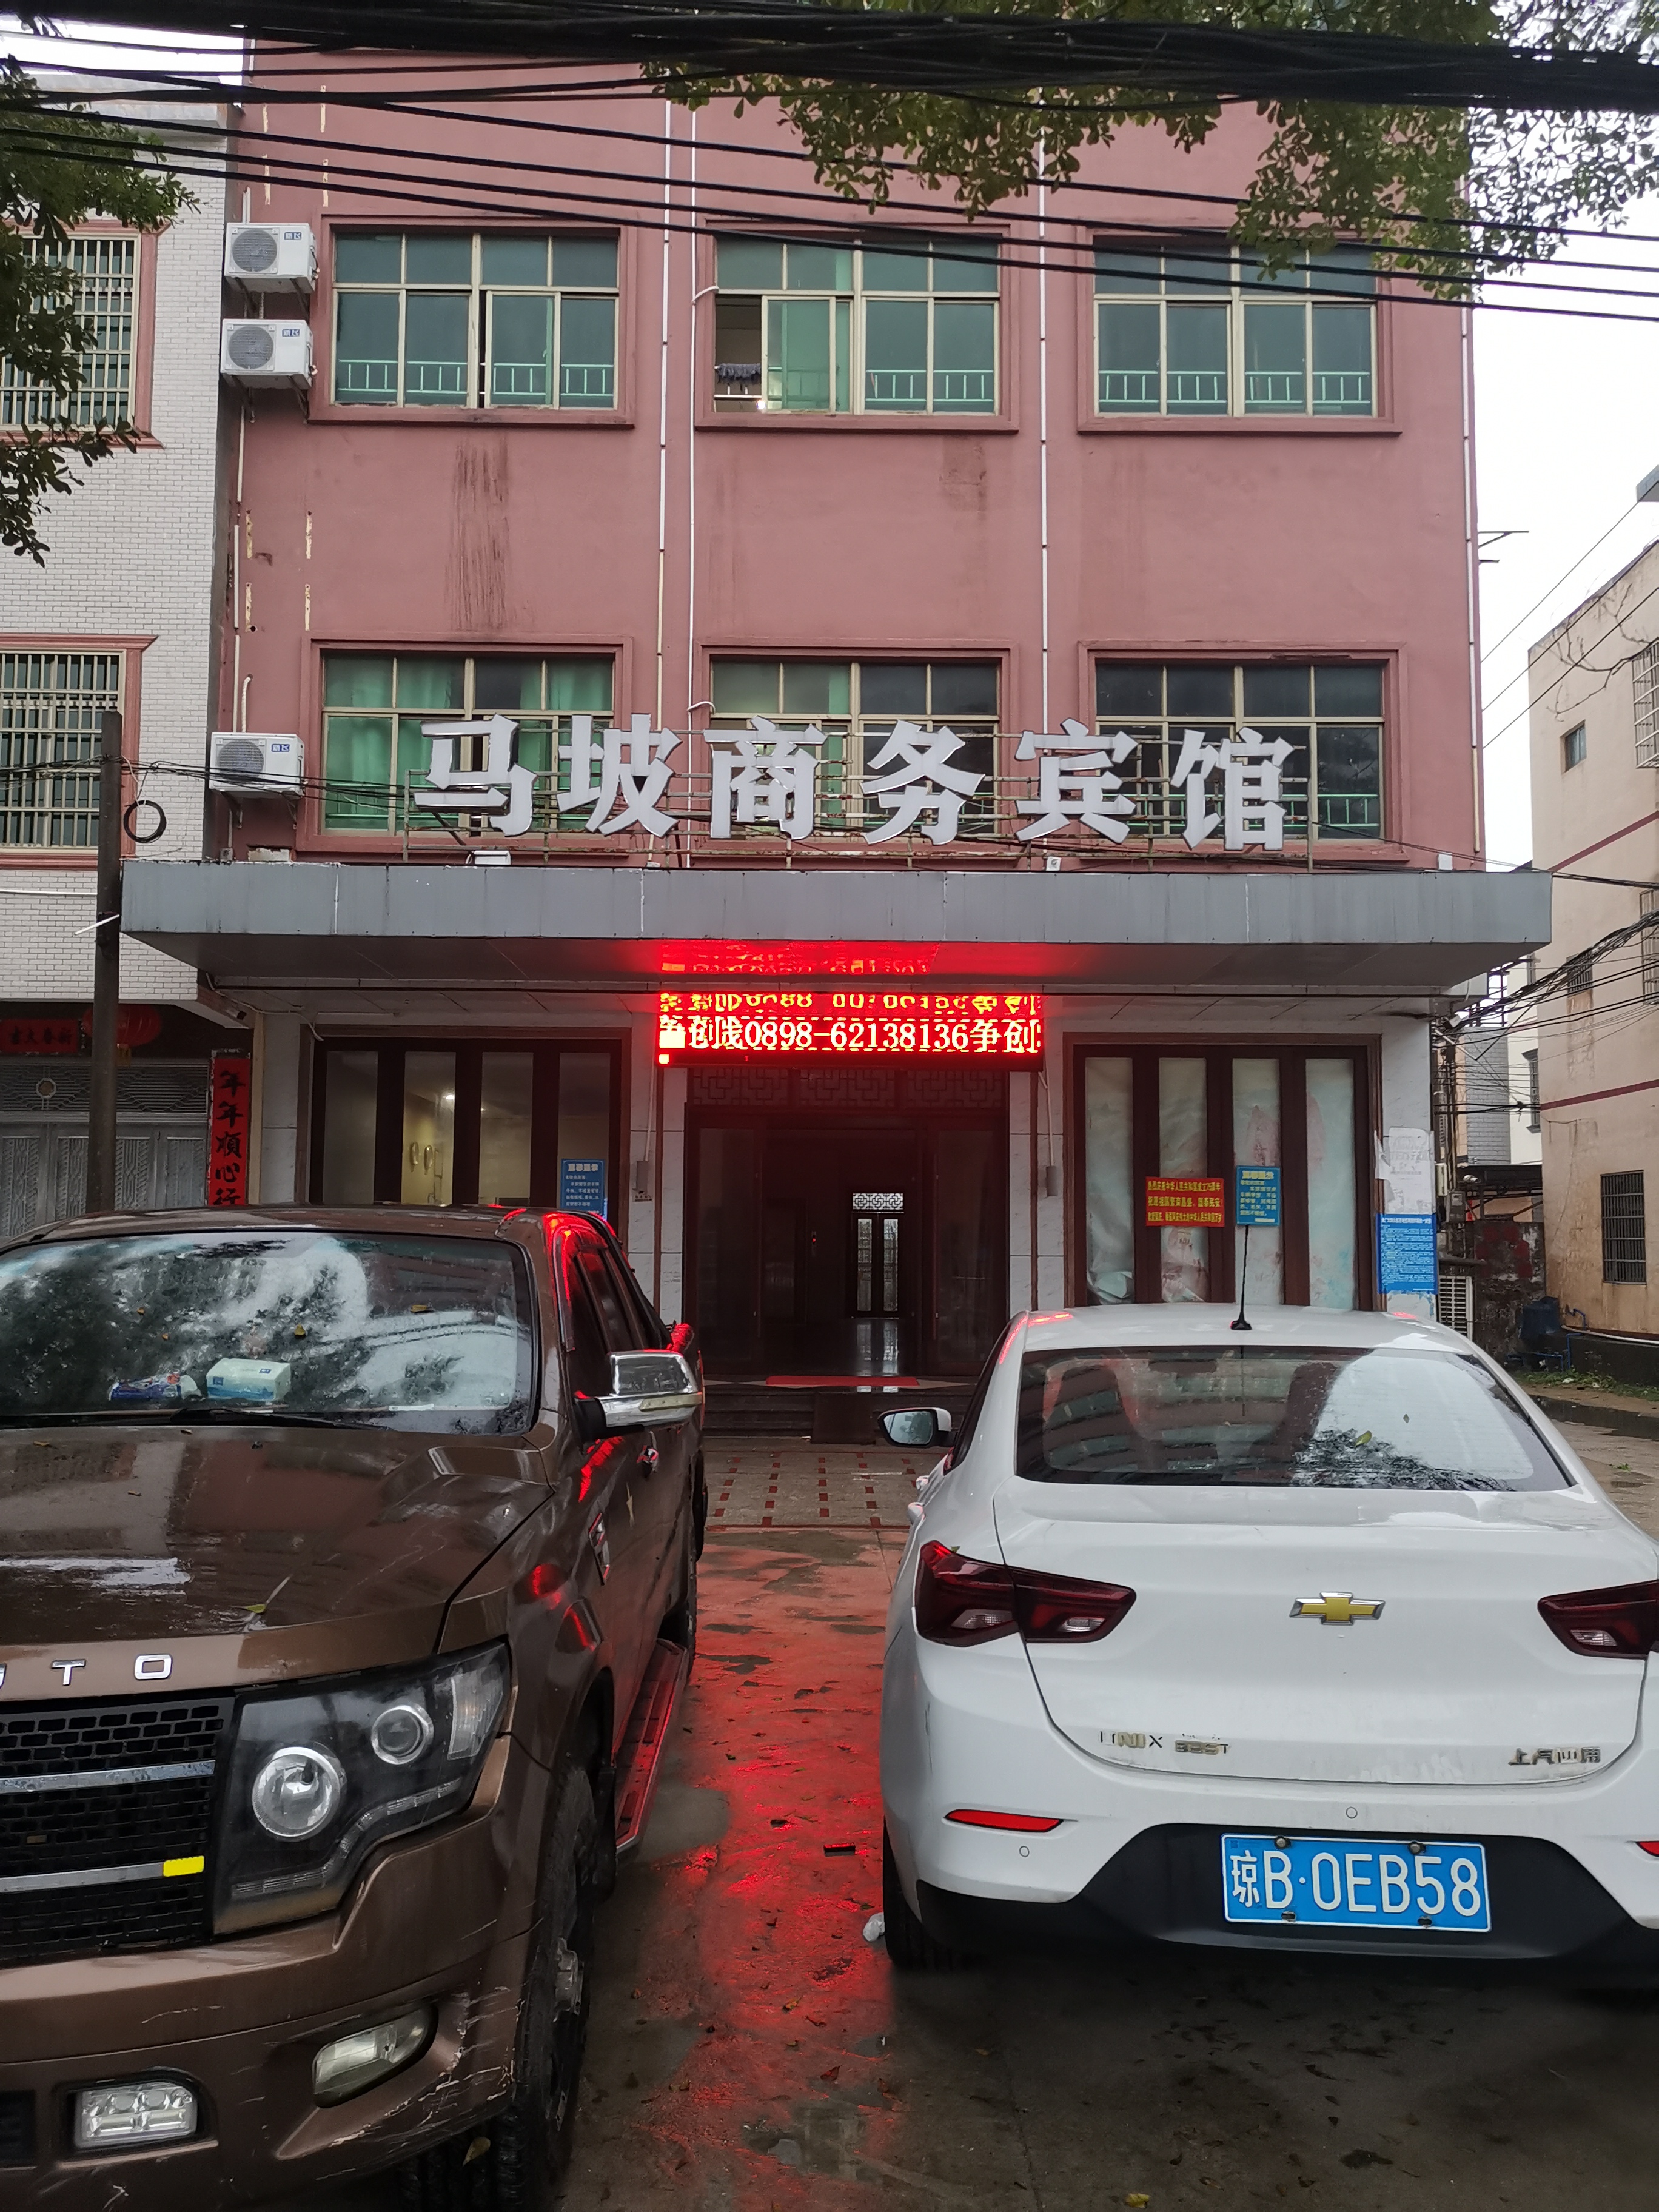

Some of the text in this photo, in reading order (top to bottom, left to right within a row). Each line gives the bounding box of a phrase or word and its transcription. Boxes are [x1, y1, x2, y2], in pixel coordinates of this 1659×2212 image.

[414, 714, 1295, 850] 马坡商务宾馆
[0, 1654, 173, 1688] TO
